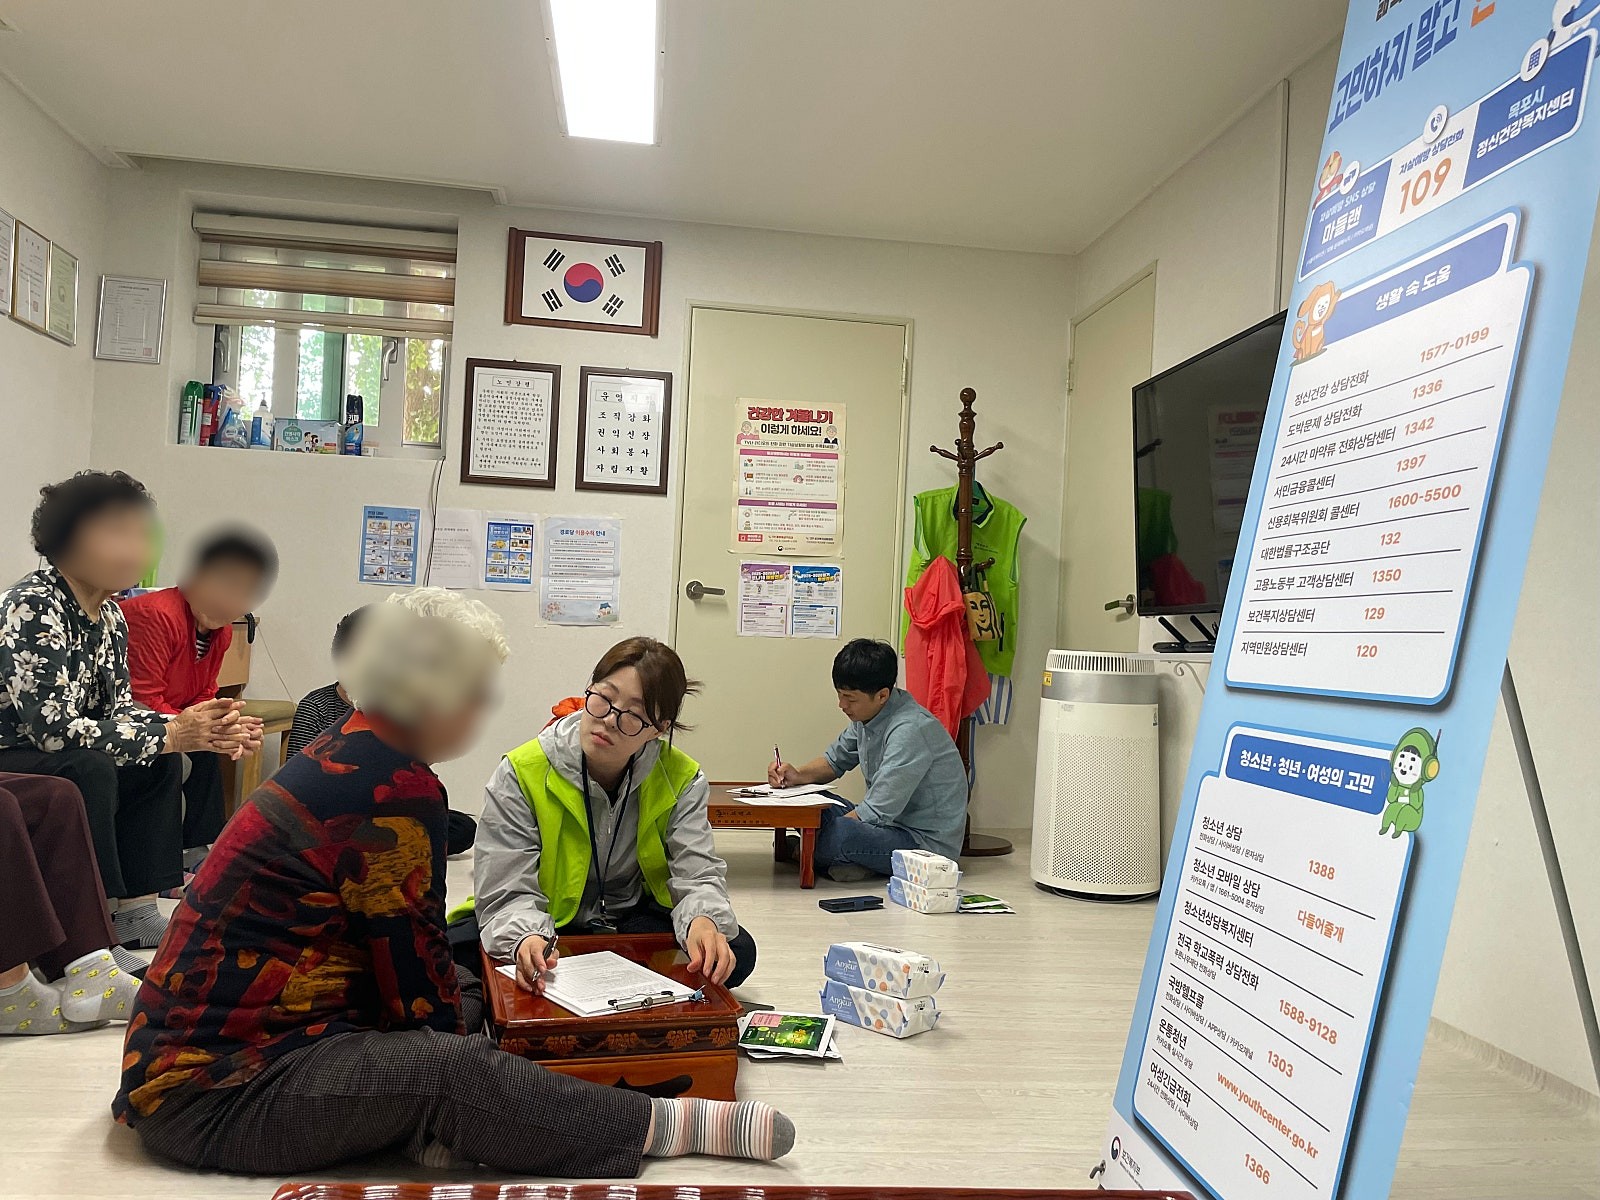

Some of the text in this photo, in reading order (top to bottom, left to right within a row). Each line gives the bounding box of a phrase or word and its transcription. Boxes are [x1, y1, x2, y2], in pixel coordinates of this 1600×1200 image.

[1328, 0, 1461, 135] 고민하지 말고
[1507, 85, 1545, 119] 목포시
[1476, 87, 1575, 159] 정신건강복지센터
[1400, 157, 1452, 214] 109
[1375, 264, 1452, 311] 생활 속 도움
[1420, 326, 1490, 363] 1577-0199
[1294, 370, 1370, 407] 정신건강 상담전화
[1412, 379, 1443, 400] 1336
[747, 406, 834, 424] 건강한 겨울나기
[1287, 403, 1363, 437] 도박문제 상담전화
[1404, 416, 1435, 437] 1342
[760, 423, 822, 436] 이렇게 하세요!
[1280, 427, 1396, 468] 24시간 마약류 전화상담센터
[1396, 454, 1426, 473] 1397
[1273, 474, 1335, 499] 서민금융콜센터
[1388, 484, 1462, 510] 1600-5500
[1267, 502, 1360, 530] 신용회복위원회 콜센터
[1260, 540, 1331, 561] 대한법률구조공단
[1380, 532, 1401, 546] 132
[1253, 571, 1354, 591] 고용노동부 고객상담센터
[1372, 568, 1401, 583] 1350
[1247, 608, 1315, 623] 보건복지상담센터
[1364, 607, 1385, 620] 129
[1241, 641, 1308, 656] 지역민원상담센터
[1356, 645, 1378, 658] 120
[1344, 771, 1375, 795] 고민
[1202, 815, 1243, 842] 청소년 상담
[1193, 858, 1261, 898] 청소년 모바일 상담
[1308, 860, 1335, 880] 1388
[1184, 900, 1254, 948] 청소년상담복지센터
[1297, 909, 1344, 943] 다들어줄개
[1177, 932, 1260, 991] 전국 학교폭력 상담전화
[1167, 975, 1205, 1010] 국방헬프콜
[1158, 1018, 1187, 1050] 온통청년
[1279, 999, 1338, 1045] 1588-9128
[1267, 1050, 1293, 1078] 1303
[1150, 1061, 1192, 1107] 여성긴급전화
[1217, 1072, 1318, 1159] www.youthcenter.go.kr
[1244, 1153, 1271, 1185] 1366
